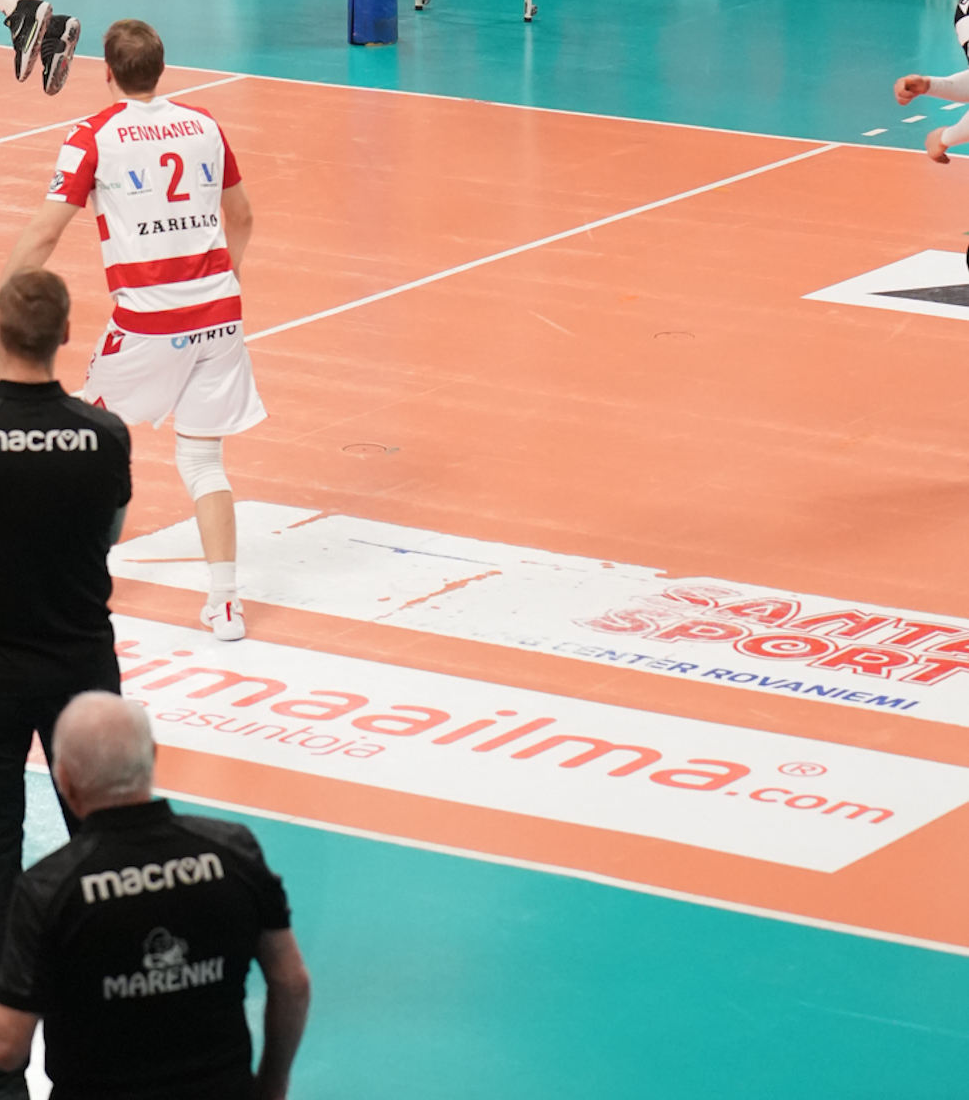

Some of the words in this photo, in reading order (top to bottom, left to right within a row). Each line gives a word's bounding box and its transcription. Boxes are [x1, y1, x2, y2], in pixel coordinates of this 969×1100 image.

[117, 119, 205, 143] PENNANEN
[159, 152, 191, 203] 2
[137, 213, 218, 236] ZARILLO
[700, 666, 921, 711] ROVANIEMI
[155, 708, 386, 758] asuntoja
[80, 852, 225, 905] macron
[102, 956, 225, 1001] MARENKI
